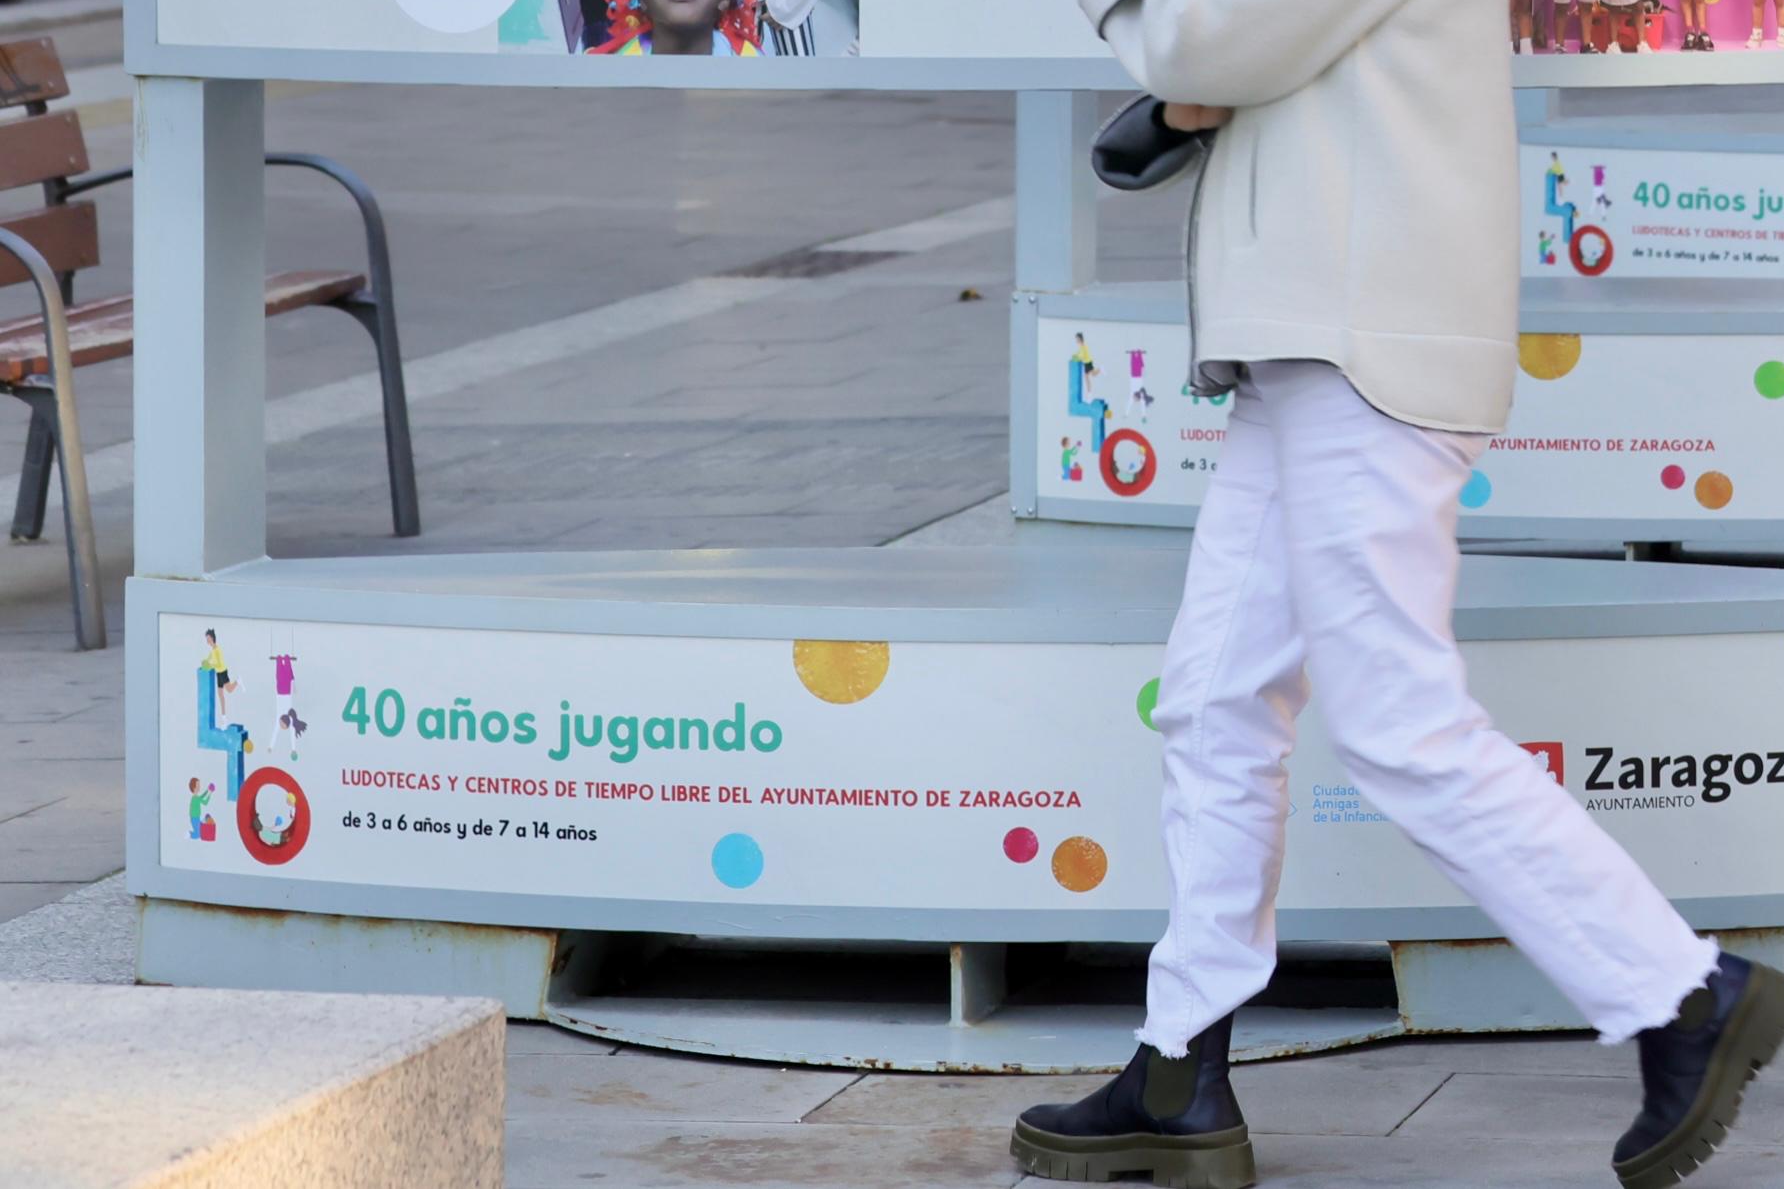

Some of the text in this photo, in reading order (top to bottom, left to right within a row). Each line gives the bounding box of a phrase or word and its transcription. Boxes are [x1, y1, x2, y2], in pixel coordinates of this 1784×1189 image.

[1632, 182, 1746, 212] 40 años
[1632, 225, 1690, 238] LUDOTECAS
[1694, 228, 1701, 238] Y
[1704, 228, 1752, 240] CENTROS
[1756, 229, 1768, 240] DE
[1632, 248, 1644, 258] de
[1674, 249, 1696, 260] años
[1708, 250, 1720, 260] de
[1756, 252, 1779, 264] años
[1489, 438, 1716, 452] AYUNTAMIENTO DE ZARAGOZA
[1180, 458, 1207, 470] de 3
[342, 686, 783, 764] 40 años jugando
[342, 768, 1082, 808] LUDOTECAS Y CENTROS DE TIEMPO LIBRE DEL AYUNTAMIENTO DE ZARAGOZA
[1312, 798, 1360, 812] Amigas
[1586, 795, 1694, 810] AYUNTAMIENTO
[1313, 812, 1341, 822] de la
[342, 811, 598, 842] de 3 a 6 años y de 7 a 14 años
